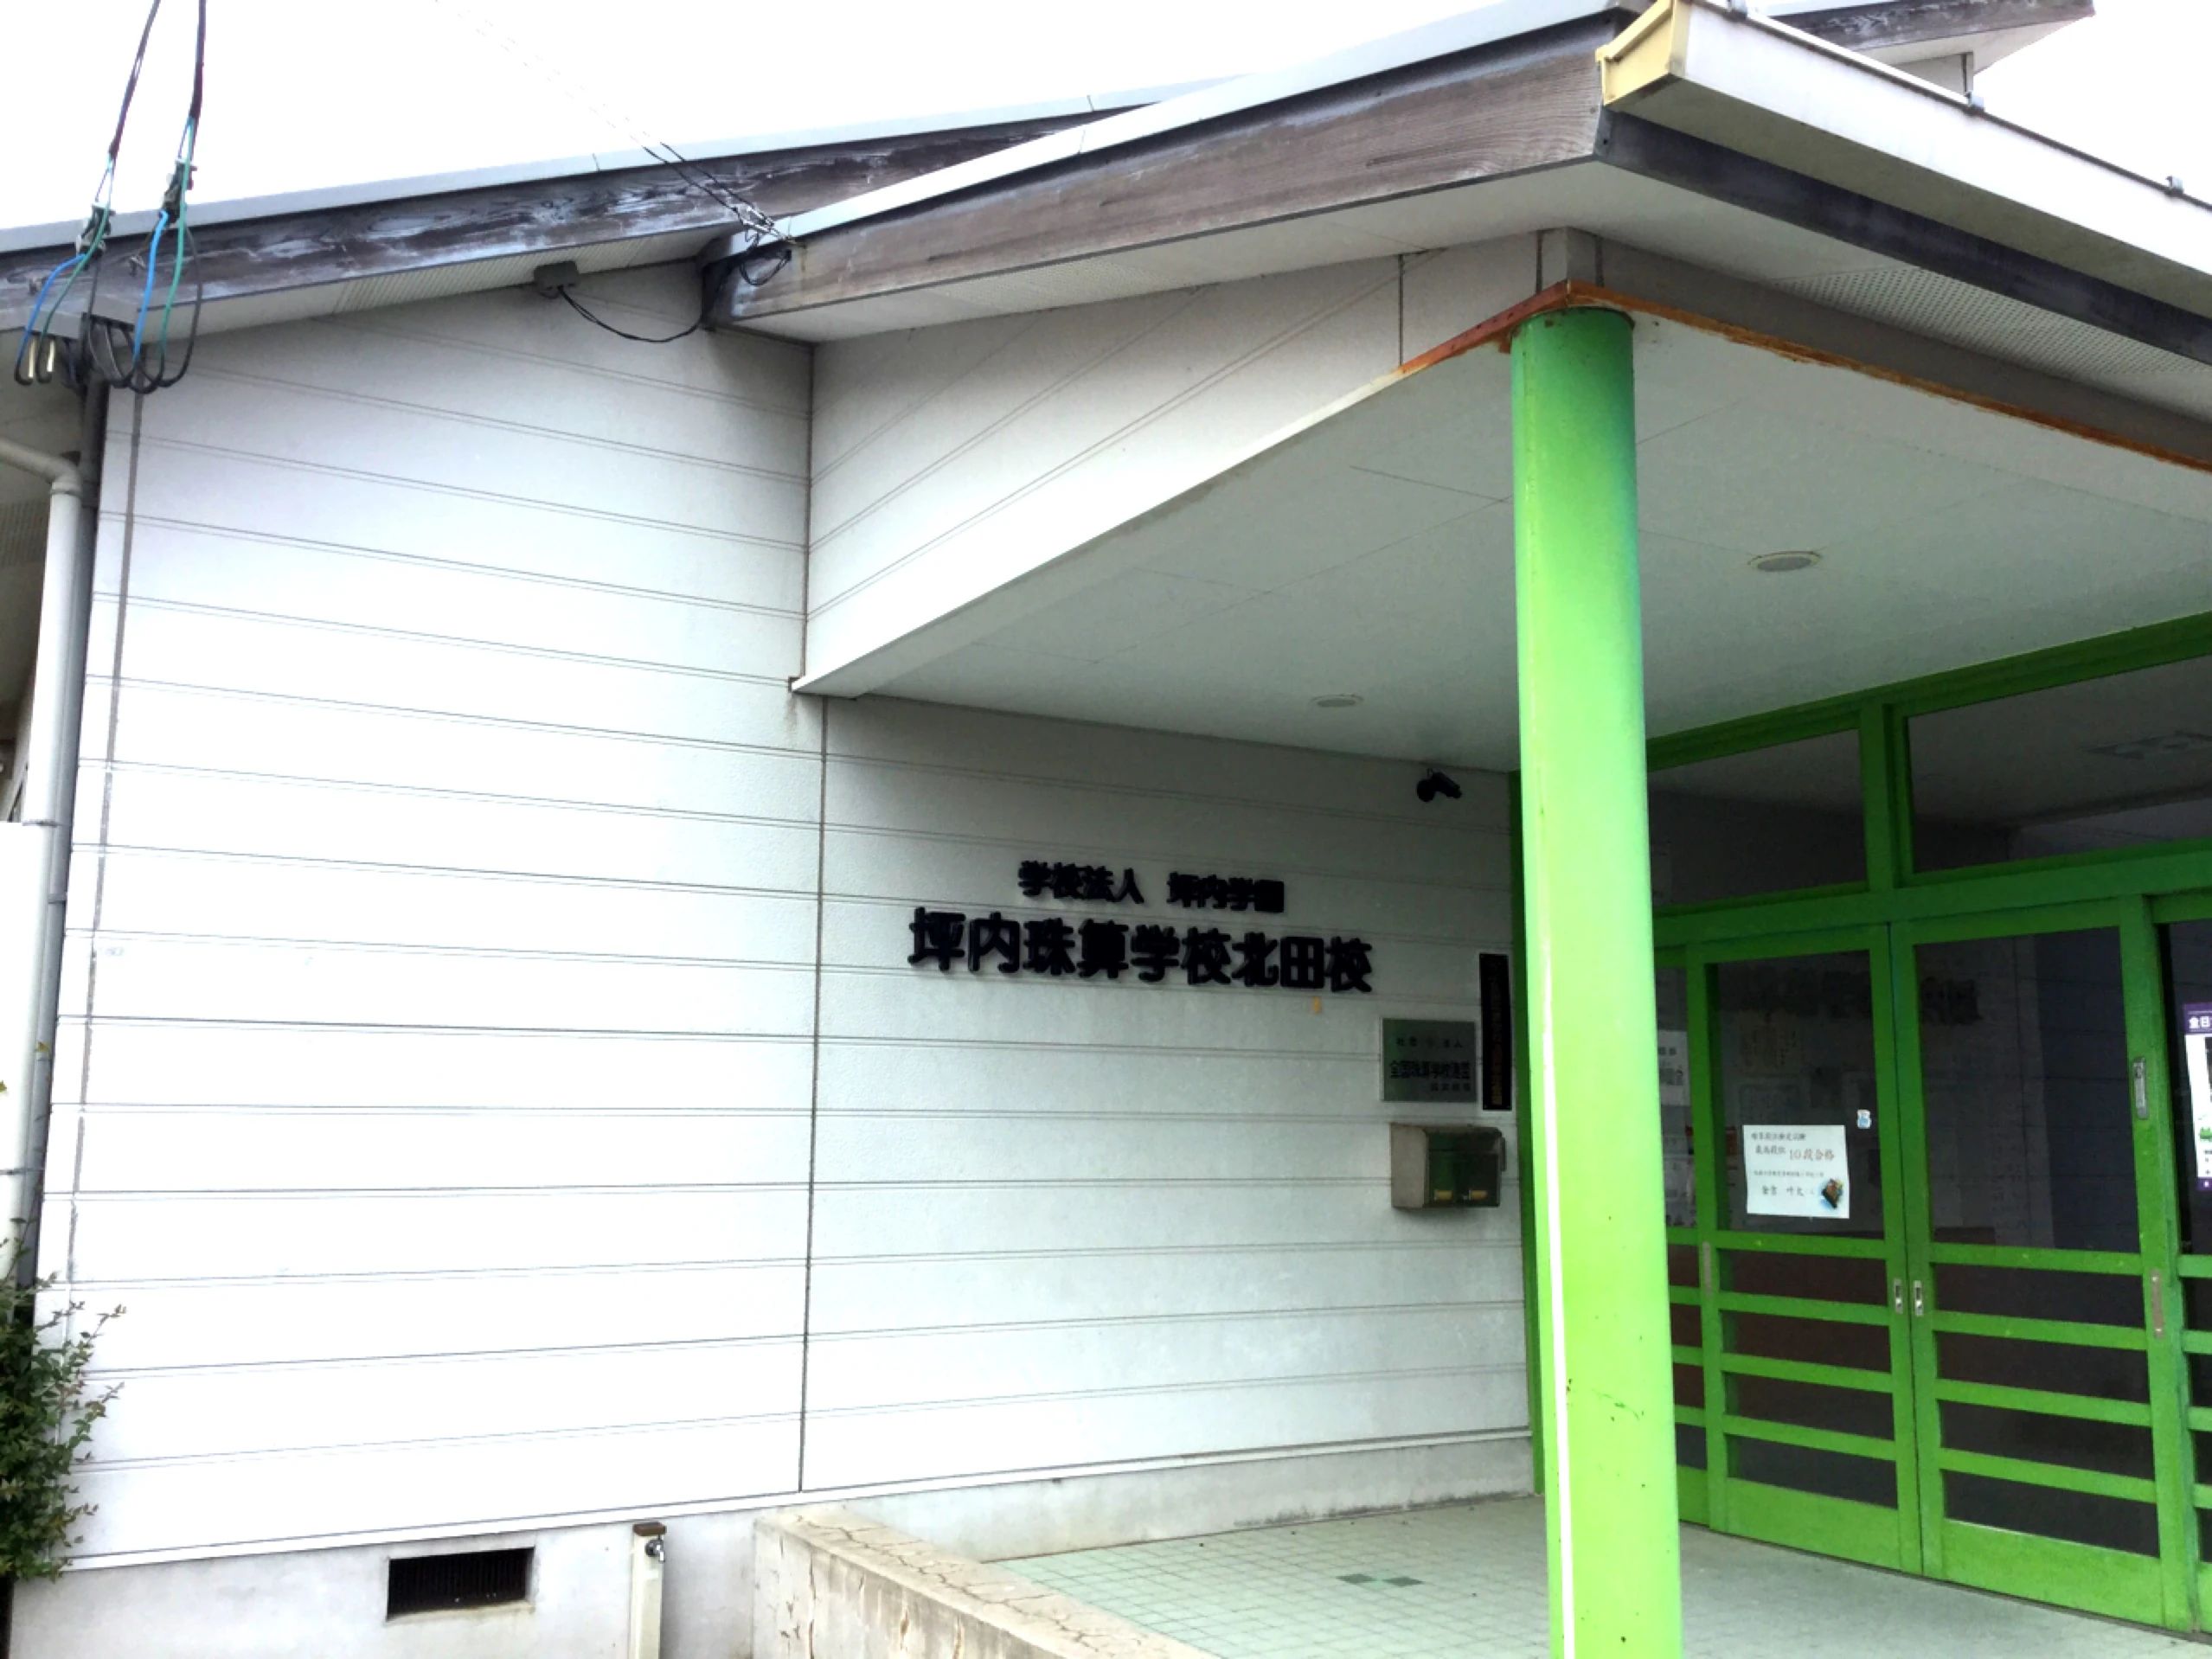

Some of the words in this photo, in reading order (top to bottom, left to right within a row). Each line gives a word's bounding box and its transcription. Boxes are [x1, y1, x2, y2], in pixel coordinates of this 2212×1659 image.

[1019, 861, 1144, 904] 学校法人
[909, 906, 1373, 992] 坪内珠算学校北田校
